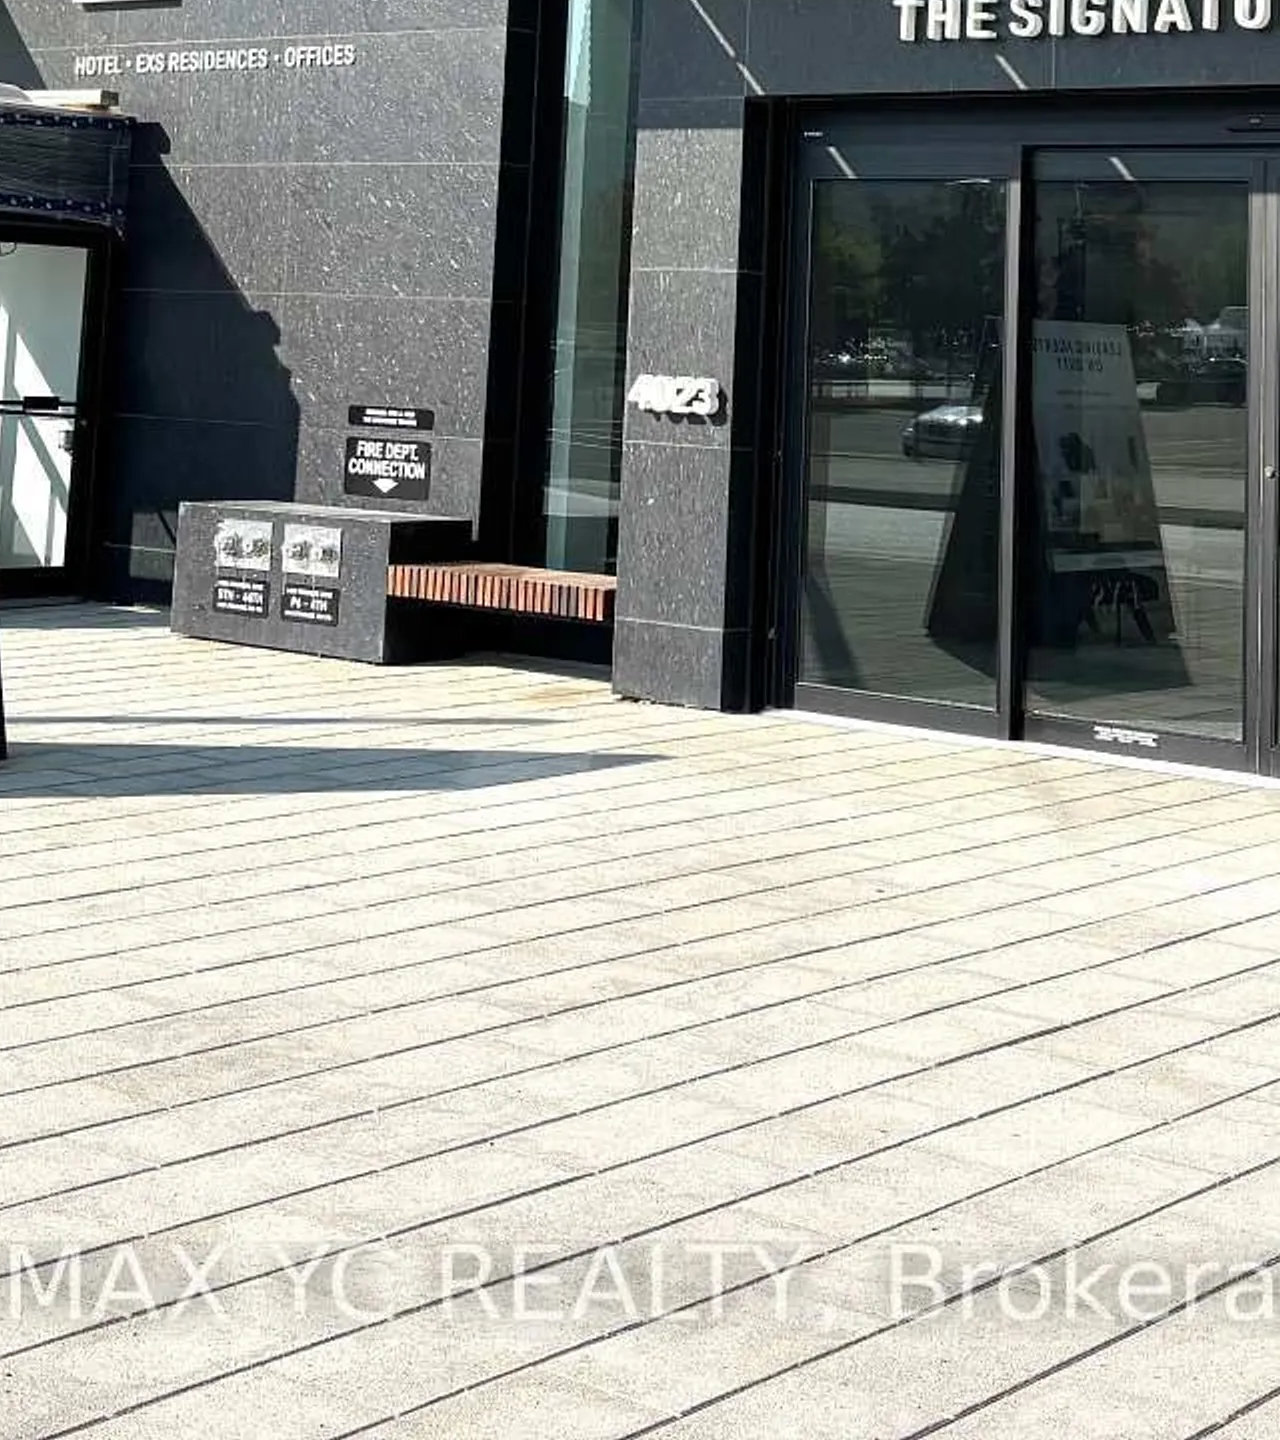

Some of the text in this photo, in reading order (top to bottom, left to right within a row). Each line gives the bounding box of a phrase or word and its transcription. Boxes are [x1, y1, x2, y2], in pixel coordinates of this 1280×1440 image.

[75, 44, 356, 76] HOTEL EXS RESIDENCES OFFICES
[357, 440, 384, 458] FIRE
[348, 458, 425, 479] CONNECTION
